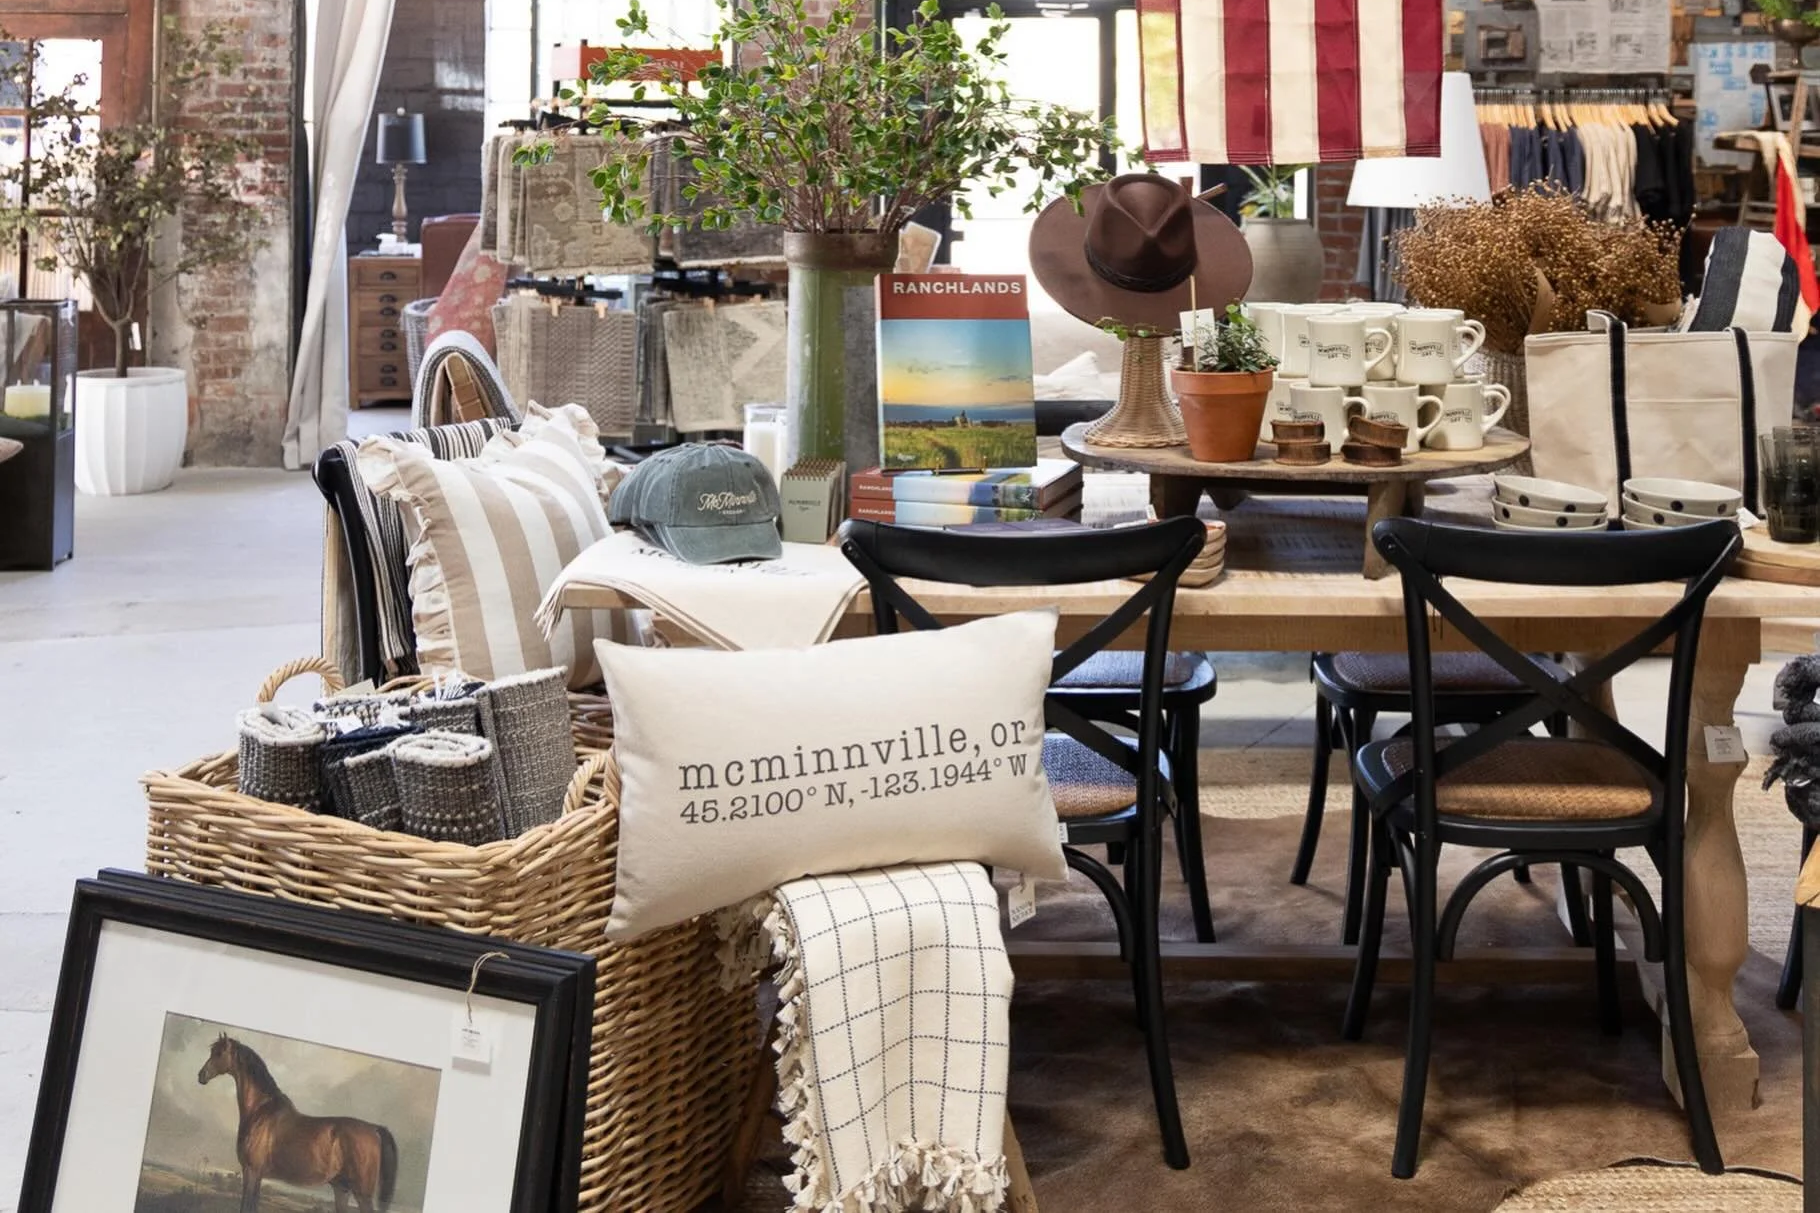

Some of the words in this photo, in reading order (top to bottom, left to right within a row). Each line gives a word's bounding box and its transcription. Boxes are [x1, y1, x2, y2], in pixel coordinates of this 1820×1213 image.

[893, 281, 1022, 294] RANCHLANDS
[679, 724, 981, 790] mcminnville,
[991, 720, 1026, 747] or
[680, 786, 818, 824] 45.2100°
[1008, 753, 1028, 776] W
